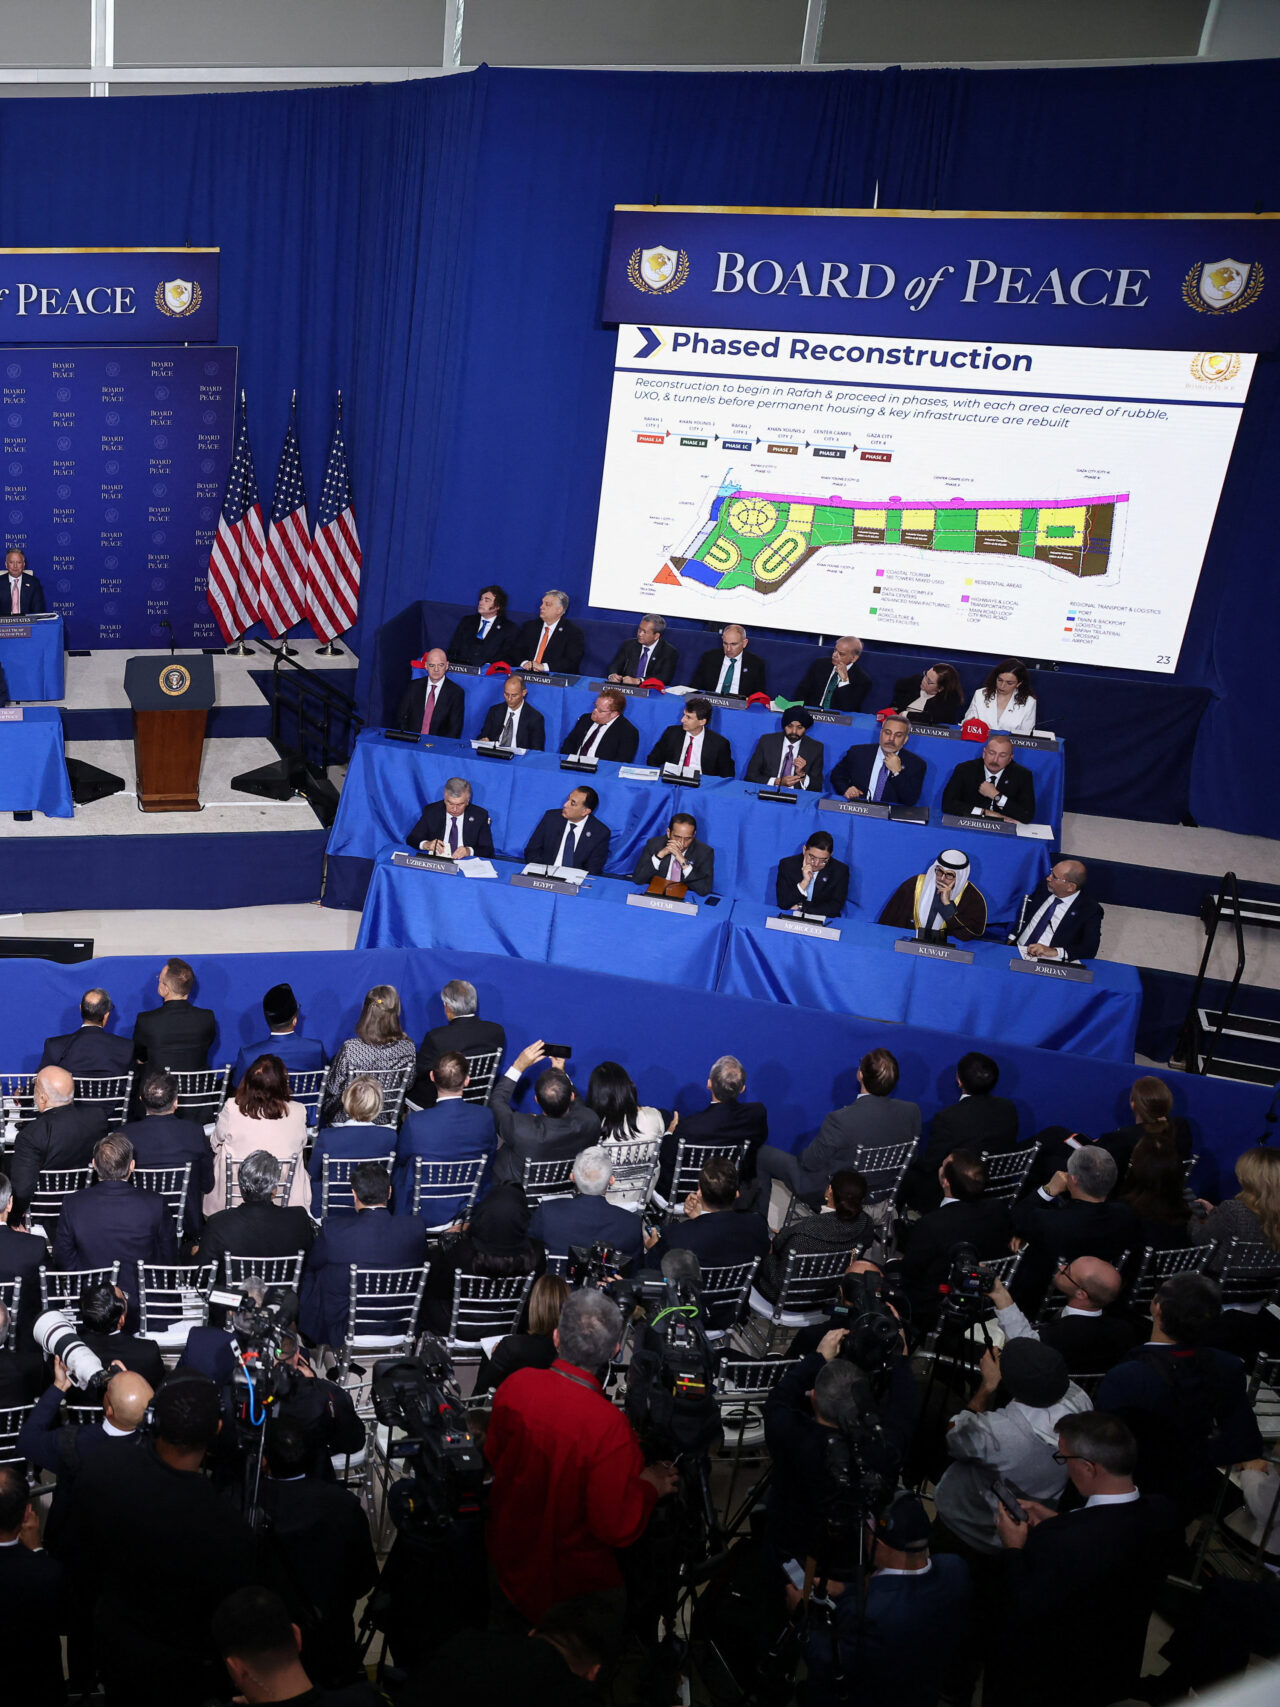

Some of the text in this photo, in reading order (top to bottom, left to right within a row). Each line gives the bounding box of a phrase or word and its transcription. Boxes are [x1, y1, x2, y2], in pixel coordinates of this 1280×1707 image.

[712, 252, 1151, 311] BOARD of PEACE
[16, 283, 137, 315] PEACE
[671, 331, 1032, 371] Phased Reconstruction
[635, 377, 1168, 420] Reconstruction to begin in Rafah & proceed in phases, with each area cleared of rubble,
[634, 390, 1070, 428] UXO, & tunnels before permanent housing & key infrastructure are rebuilt
[1156, 655, 1171, 664] 23
[524, 675, 552, 683] HUNGARY
[811, 714, 835, 722] KISTAN
[916, 728, 950, 737] SALVADOR
[967, 726, 982, 734] USA
[959, 819, 1000, 830] AZERBAIJAN
[406, 859, 445, 871] UZBEKISTAN
[533, 881, 554, 889] EGYPT
[650, 900, 673, 909] QATAR
[918, 947, 950, 958] KUWAIT
[1035, 965, 1068, 976] JORDAN
